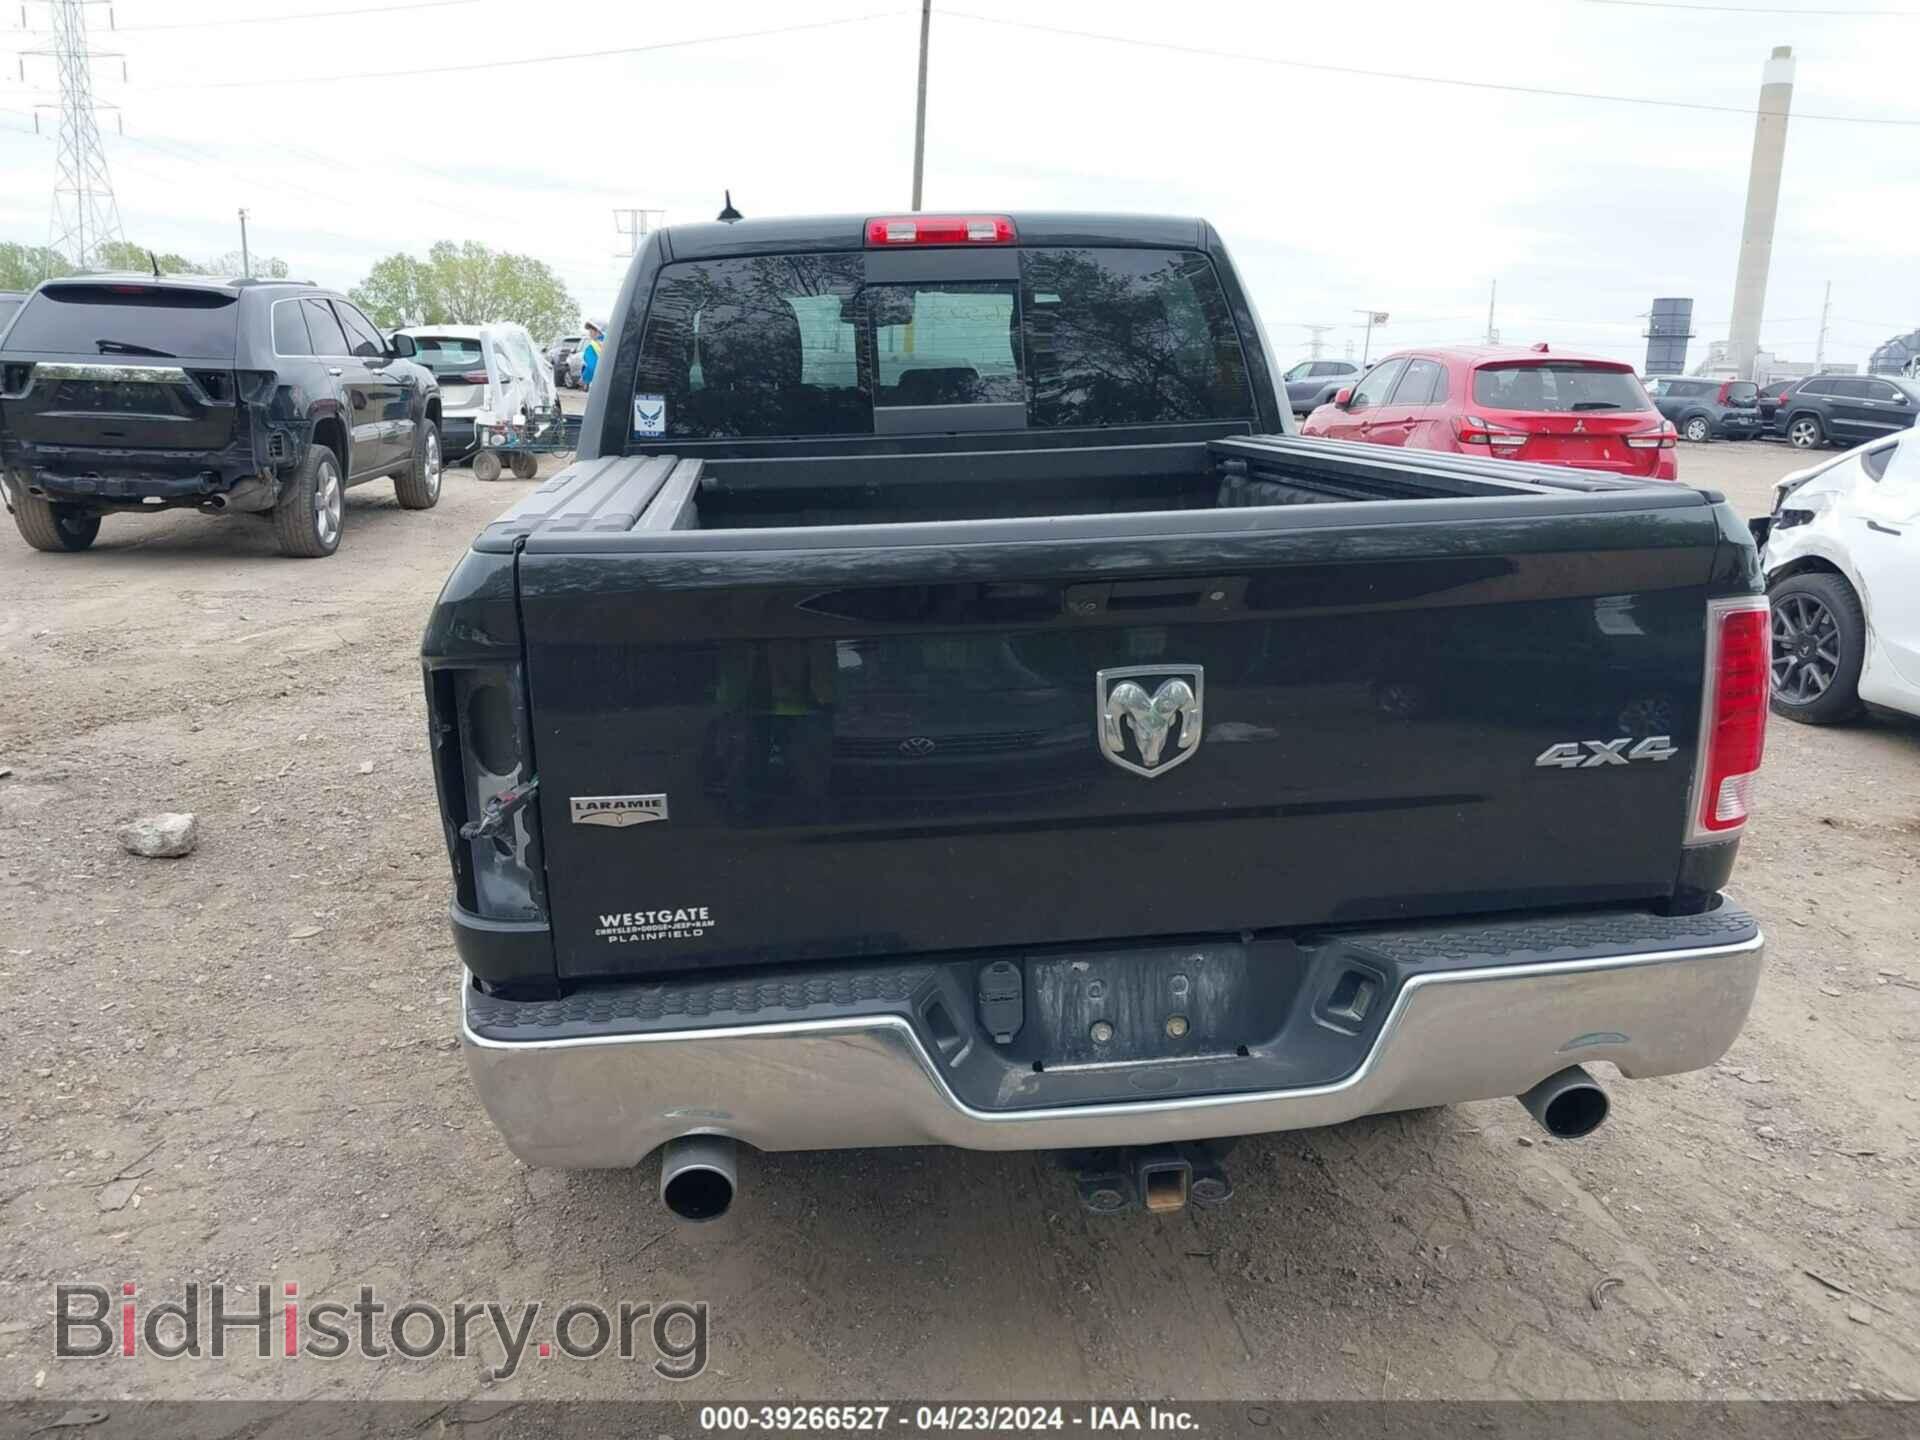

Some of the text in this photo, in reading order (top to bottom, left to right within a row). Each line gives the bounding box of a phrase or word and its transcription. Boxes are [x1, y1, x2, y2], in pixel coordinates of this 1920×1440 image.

[575, 799, 662, 810] LARAMIE
[599, 907, 710, 927] WESTGATE
[608, 928, 704, 943] PLAINFIELD
